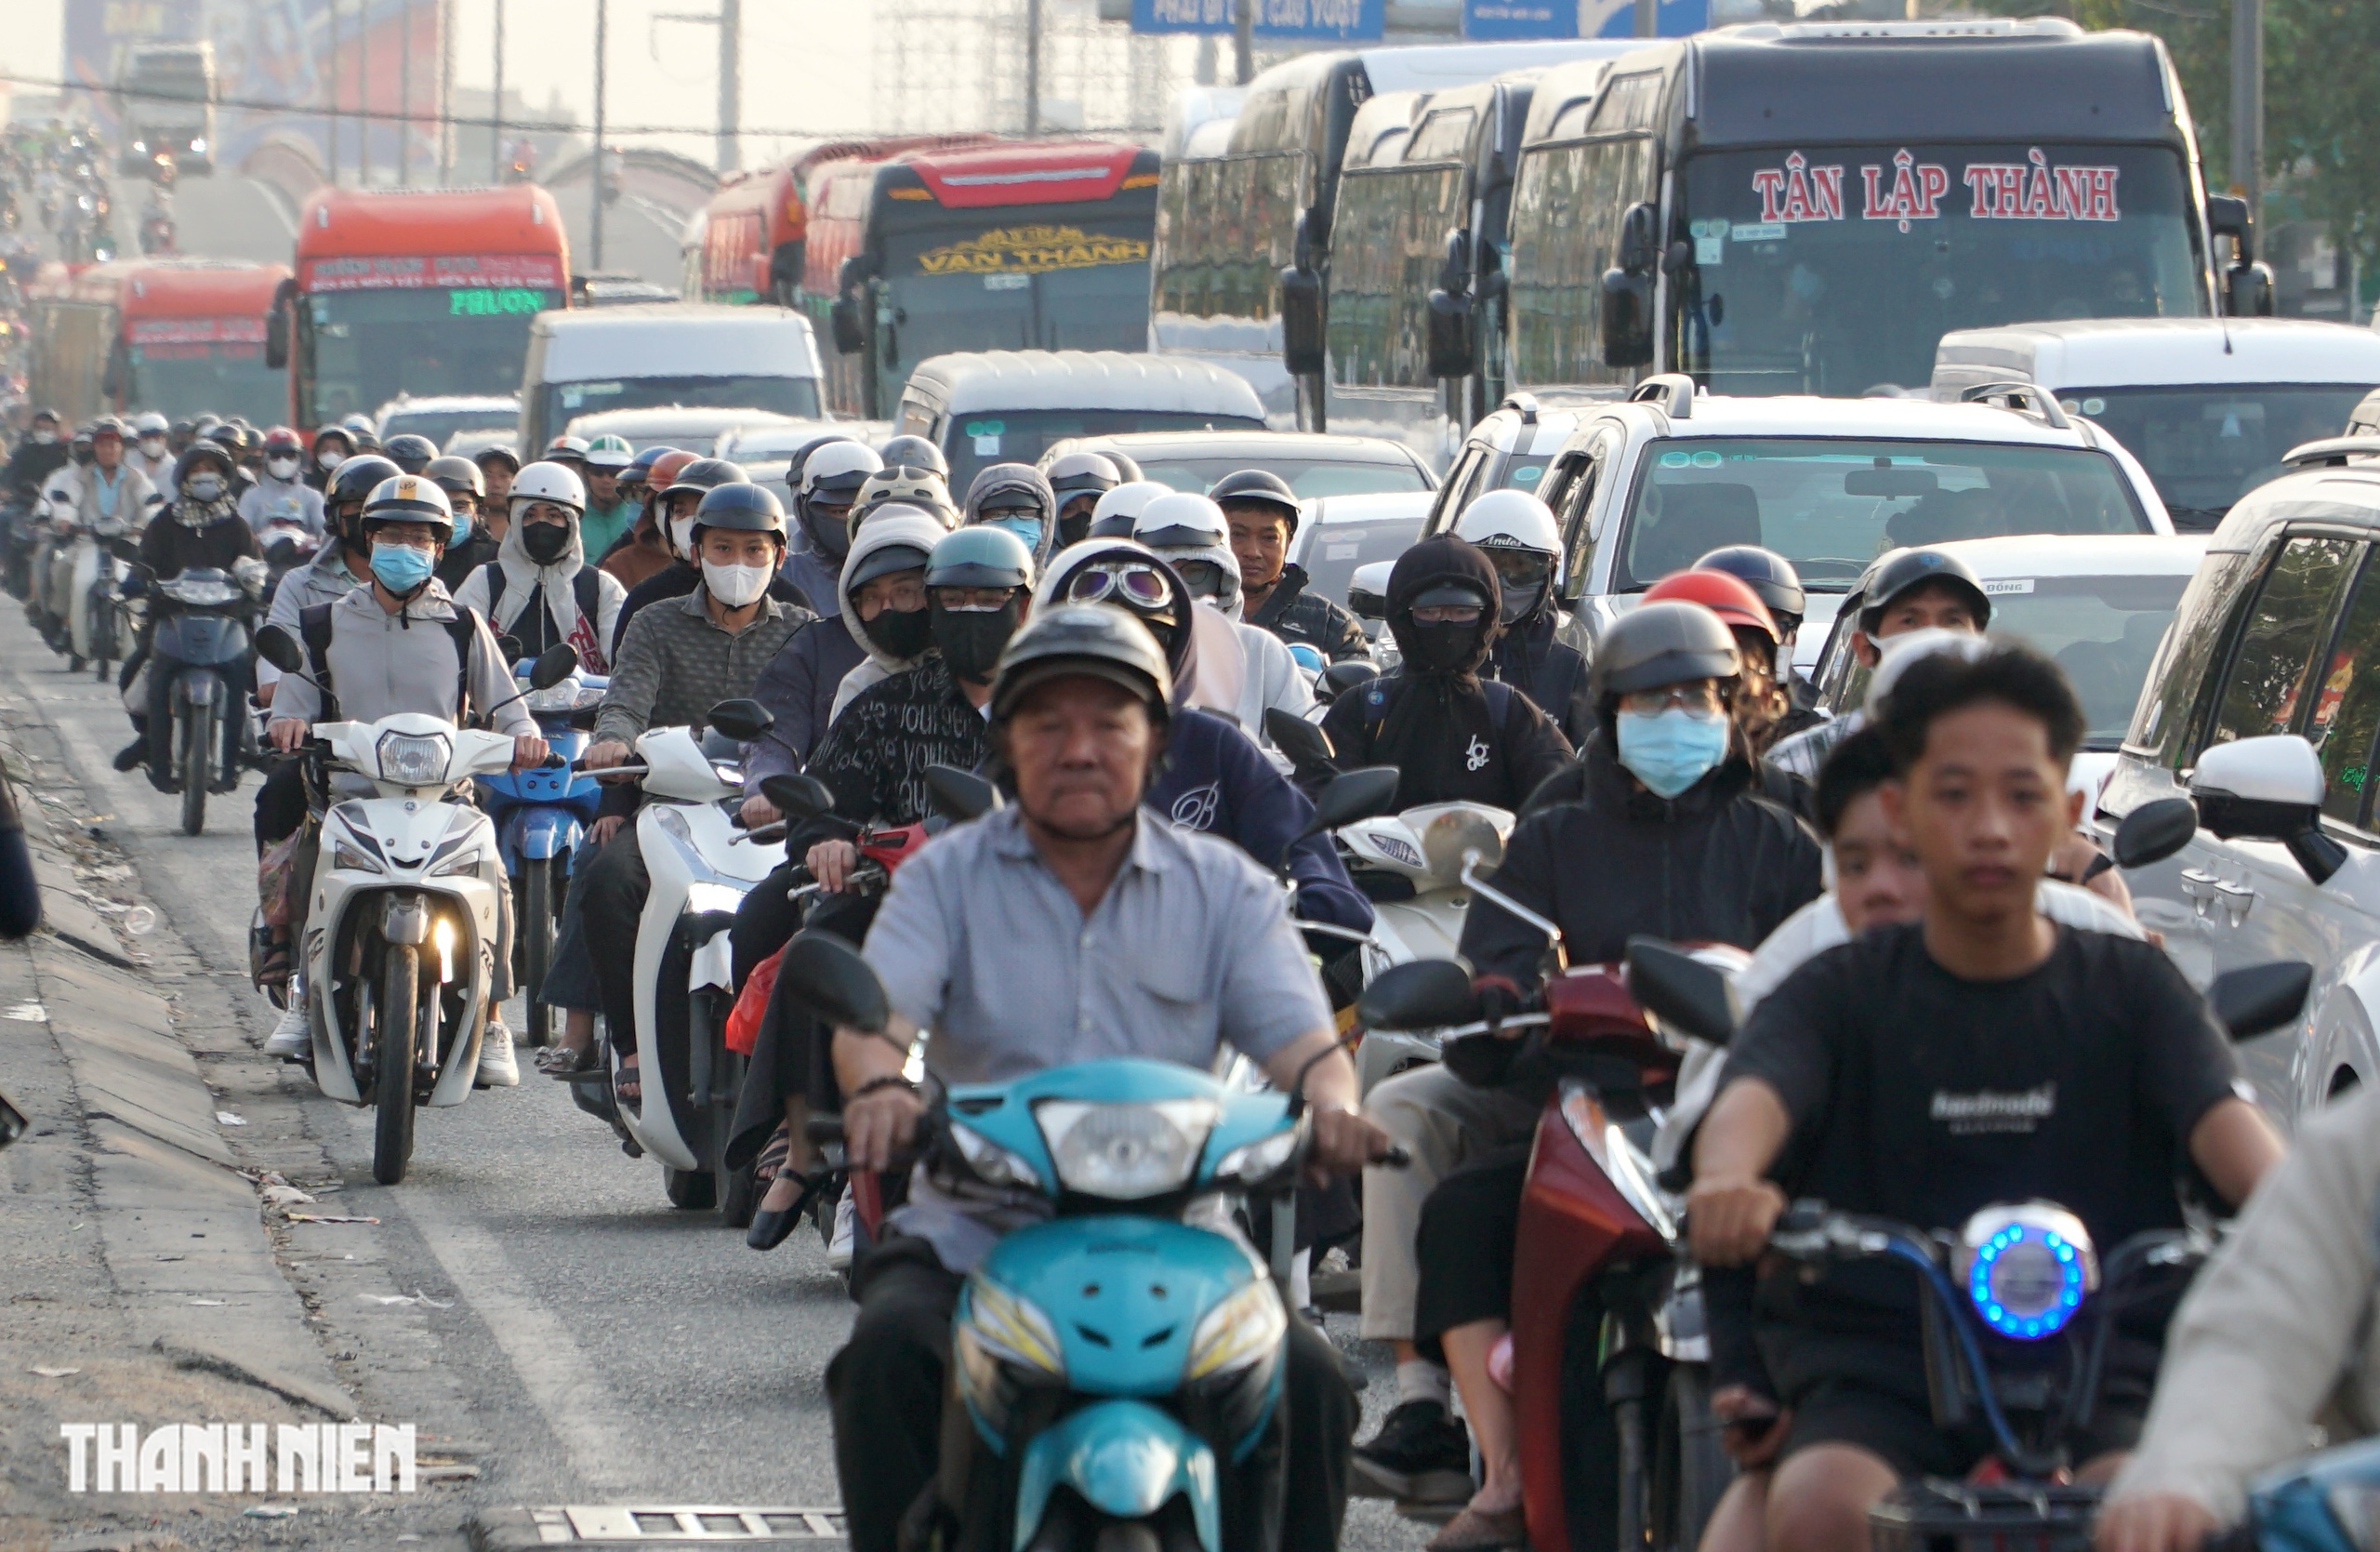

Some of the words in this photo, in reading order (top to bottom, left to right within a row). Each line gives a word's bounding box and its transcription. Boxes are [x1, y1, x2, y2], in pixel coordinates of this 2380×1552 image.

[1752, 150, 1844, 223] TÂN
[1860, 147, 1950, 234] LẬP
[1964, 146, 2120, 221] THÀNH
